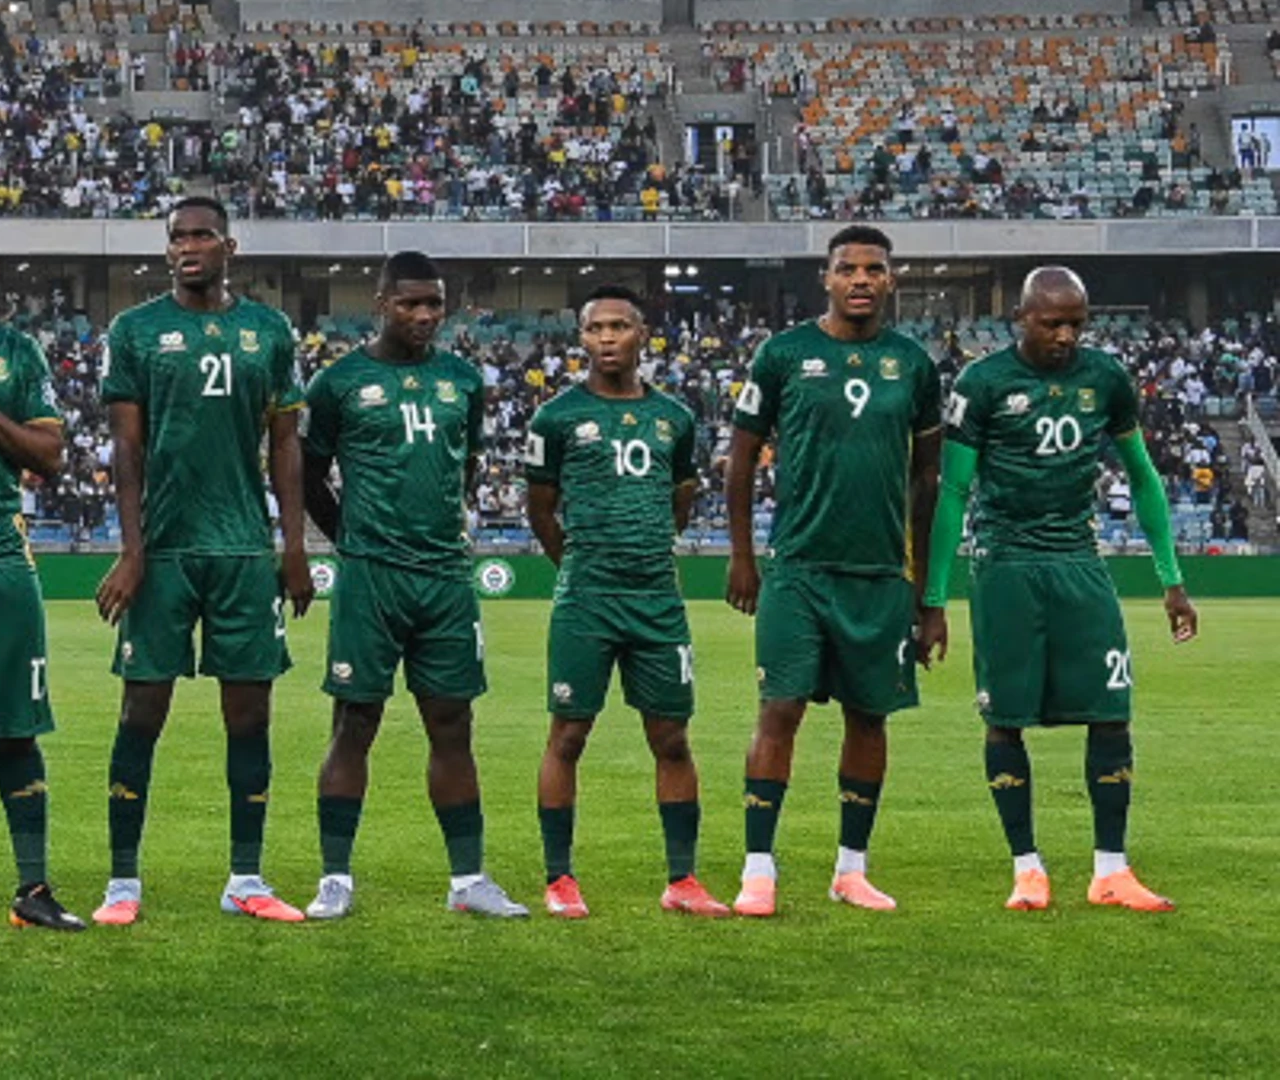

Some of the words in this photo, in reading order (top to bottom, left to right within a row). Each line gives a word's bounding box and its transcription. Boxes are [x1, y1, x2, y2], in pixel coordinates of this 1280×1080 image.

[199, 354, 233, 397] 21
[844, 378, 871, 418] 9
[399, 402, 437, 445] 14
[1035, 415, 1083, 456] 20
[610, 438, 651, 478] 10
